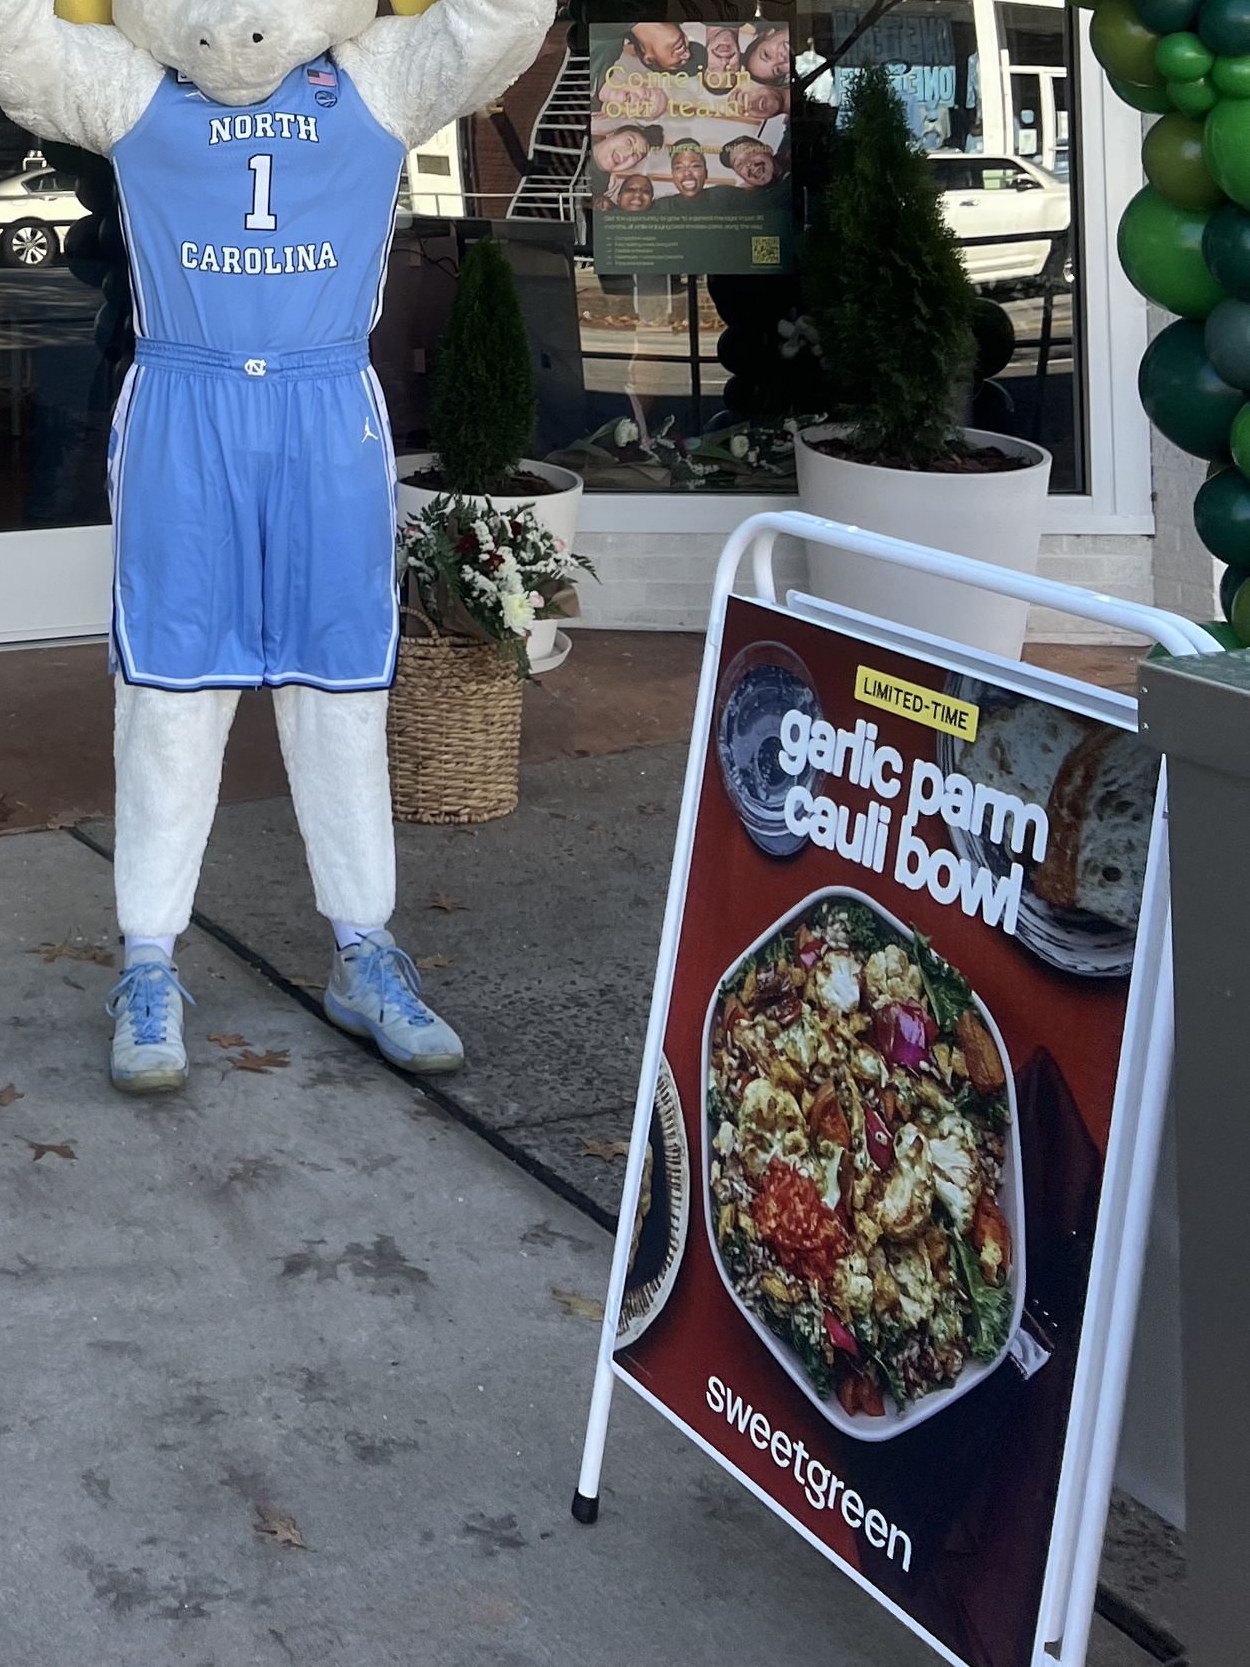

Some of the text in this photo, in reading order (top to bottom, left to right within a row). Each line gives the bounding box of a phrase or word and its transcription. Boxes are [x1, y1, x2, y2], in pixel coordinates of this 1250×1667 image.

[605, 65, 752, 94] Come join
[605, 94, 751, 118] our team!
[209, 112, 320, 146] NORTH
[244, 154, 277, 231] 1
[181, 241, 338, 275] CAROLINA
[863, 677, 970, 731] LIMITED-TIME
[779, 709, 1050, 863] garlic parm
[784, 785, 1024, 935] cauli bowl
[706, 1375, 912, 1573] sweetgreen
